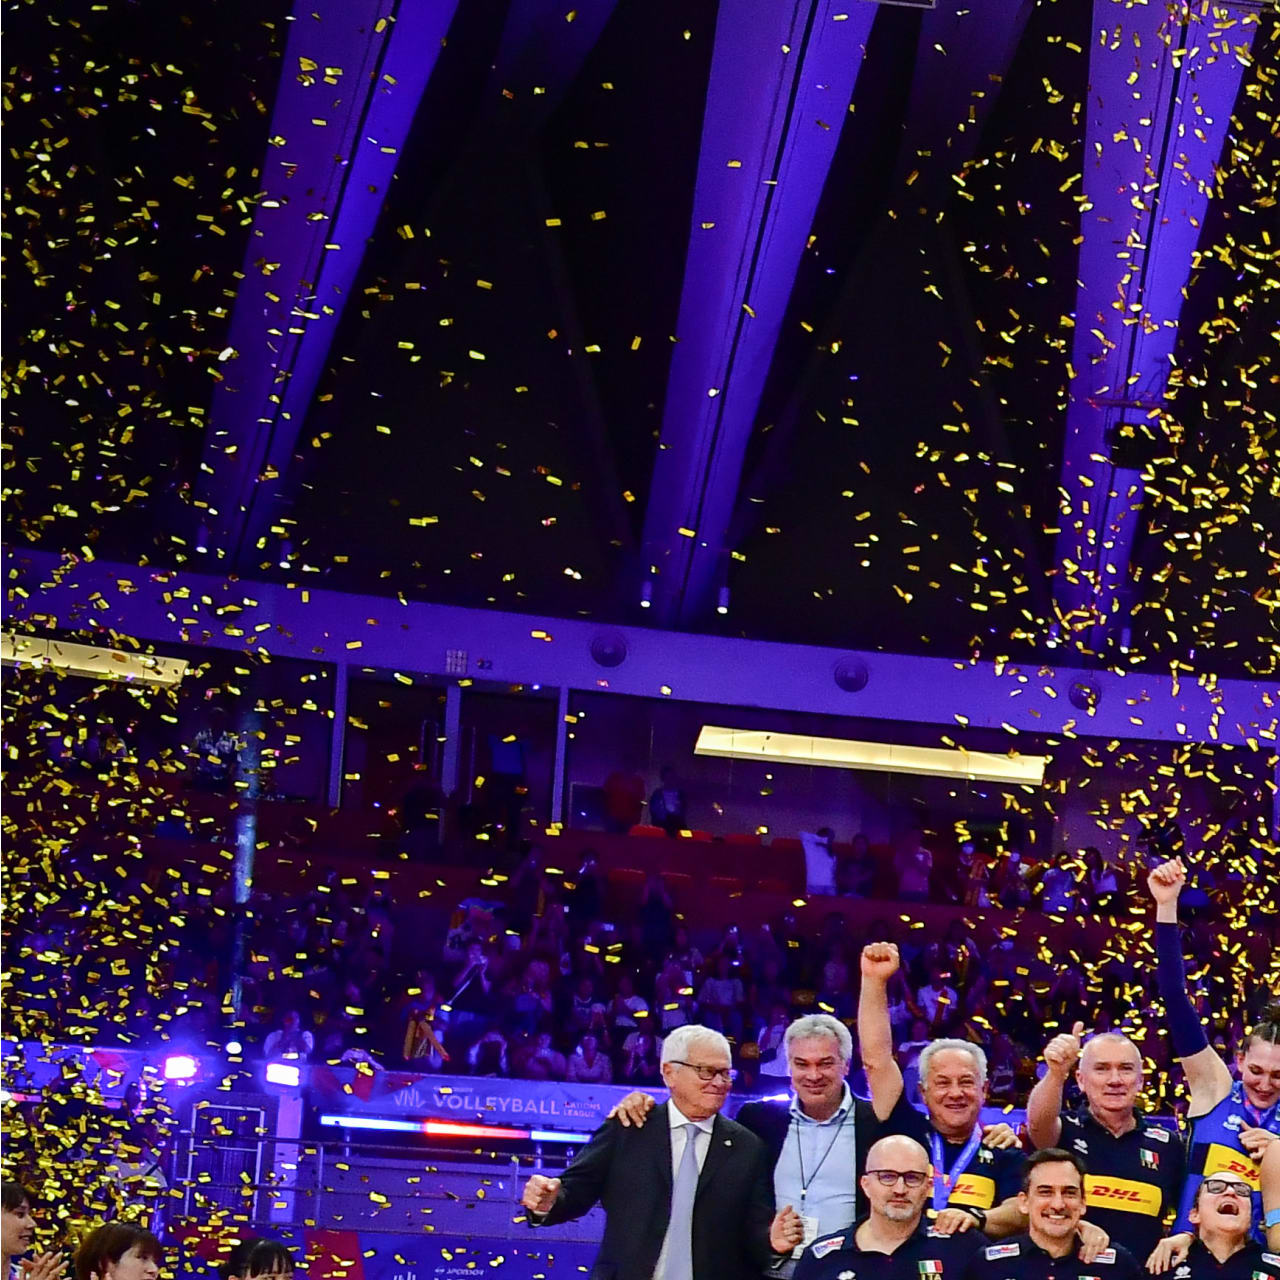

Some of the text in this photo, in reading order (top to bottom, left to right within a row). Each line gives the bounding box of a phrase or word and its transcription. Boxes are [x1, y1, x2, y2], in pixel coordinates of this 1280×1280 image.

[433, 1093, 560, 1116] VOLLEYBALL
[1228, 1160, 1260, 1181] DH
[1091, 1185, 1141, 1202] DHL
